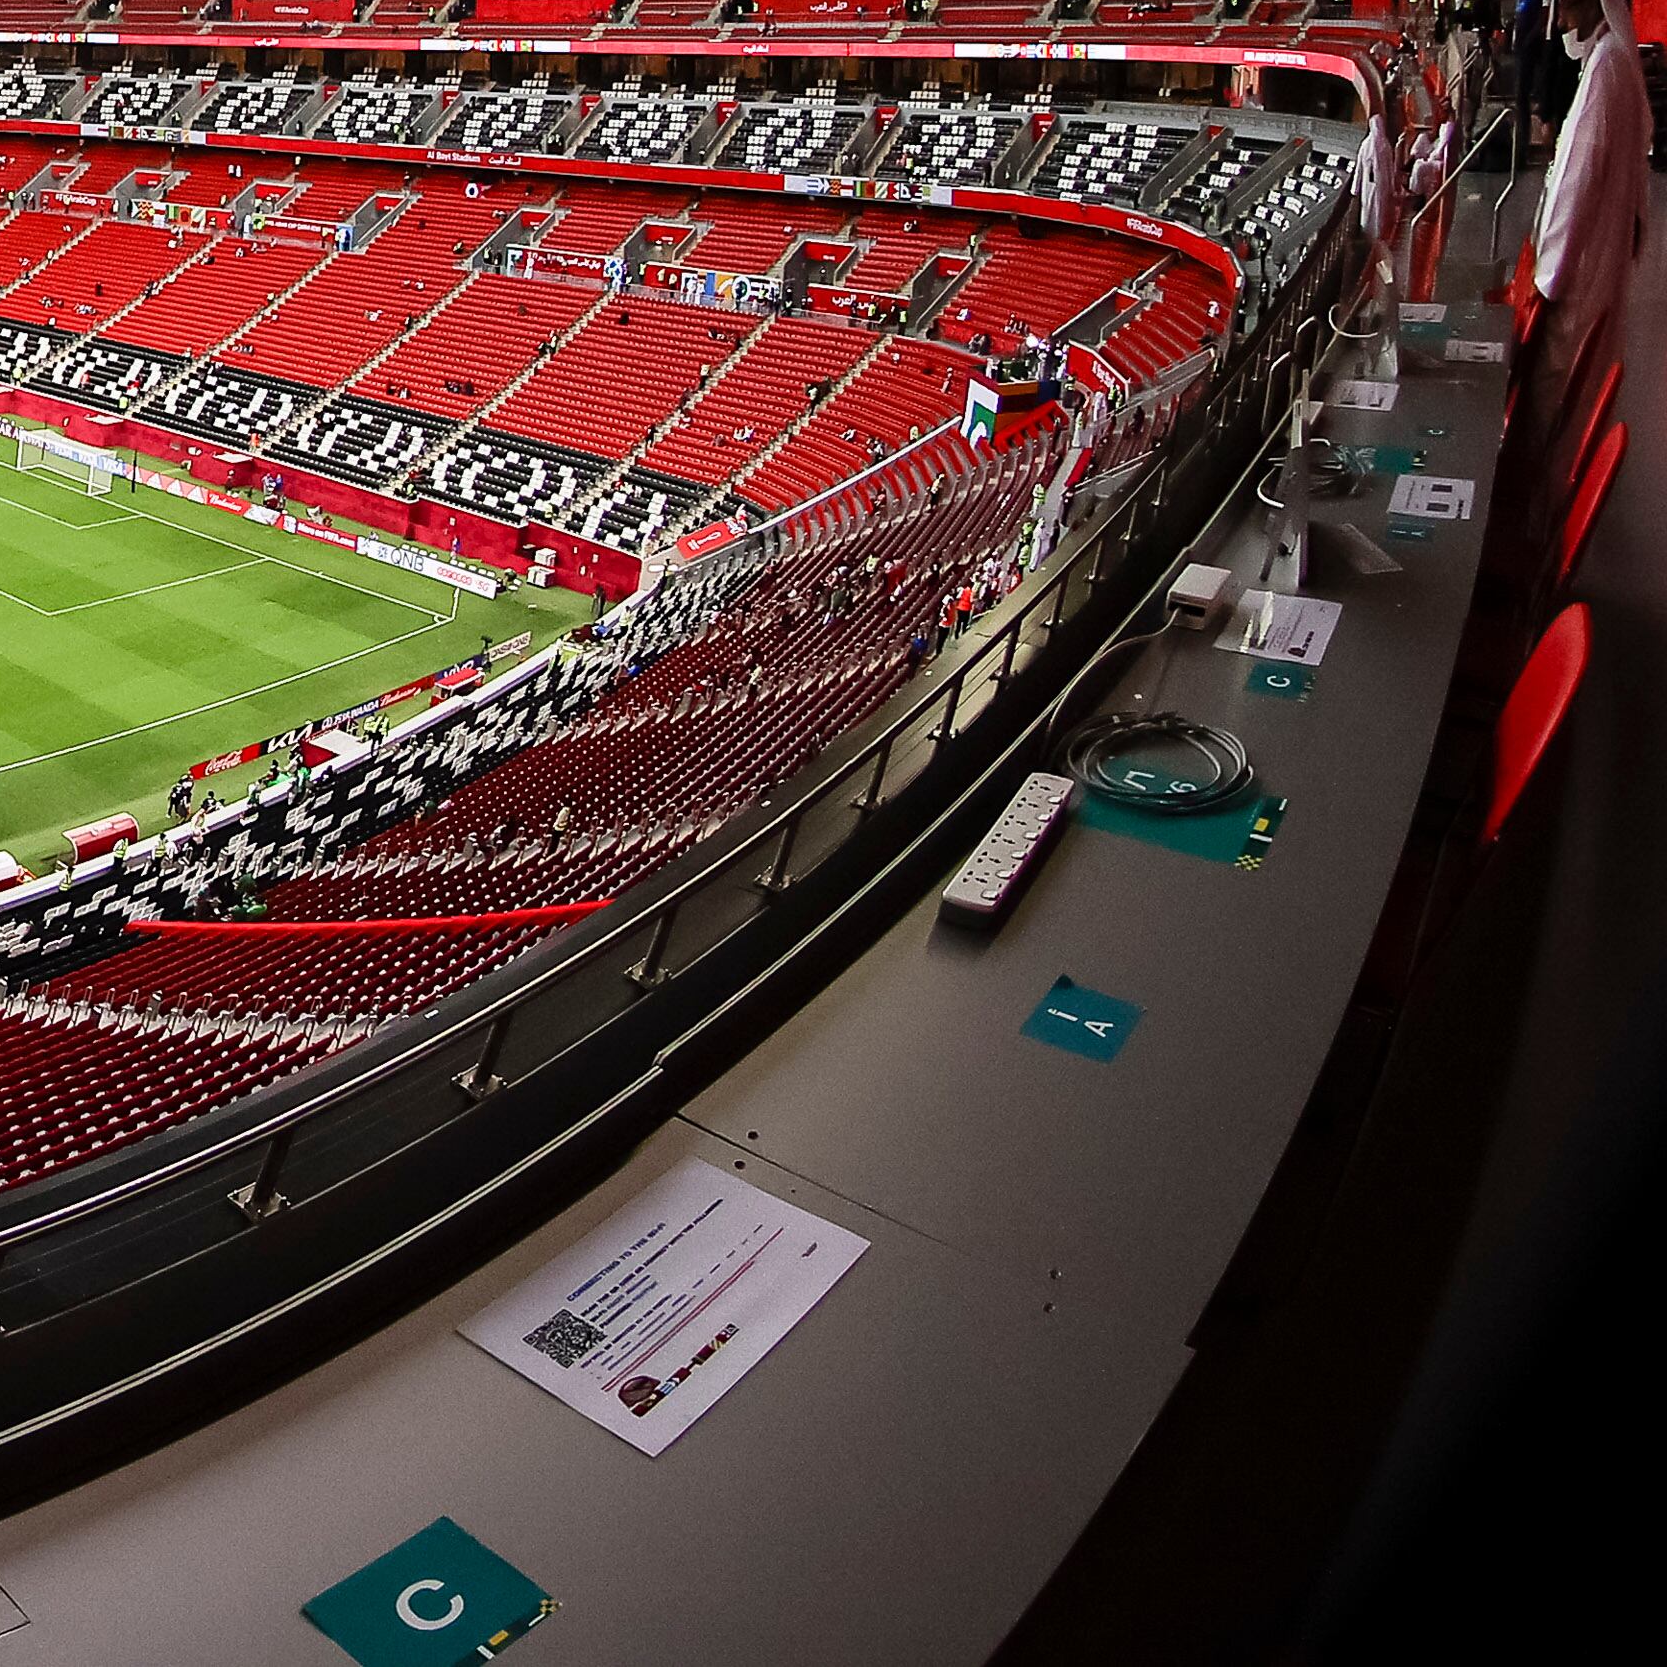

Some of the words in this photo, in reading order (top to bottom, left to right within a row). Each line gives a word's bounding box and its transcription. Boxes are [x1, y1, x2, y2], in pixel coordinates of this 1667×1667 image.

[426, 151, 435, 160] Al
[435, 152, 451, 162] Bayt
[452, 153, 481, 164] Stadium
[101, 456, 123, 475] VISA
[208, 493, 242, 512] Budweiser
[390, 548, 424, 573] QNB
[1266, 675, 1291, 688] C
[379, 686, 421, 708] Budweiser
[267, 722, 314, 754] KIA
[205, 749, 243, 776] Coca-Cola
[1083, 1020, 1114, 1038] A
[567, 1260, 621, 1302] CONNECTING
[619, 1249, 633, 1261] TO
[630, 1237, 648, 1252] THE
[395, 1579, 465, 1631] C
